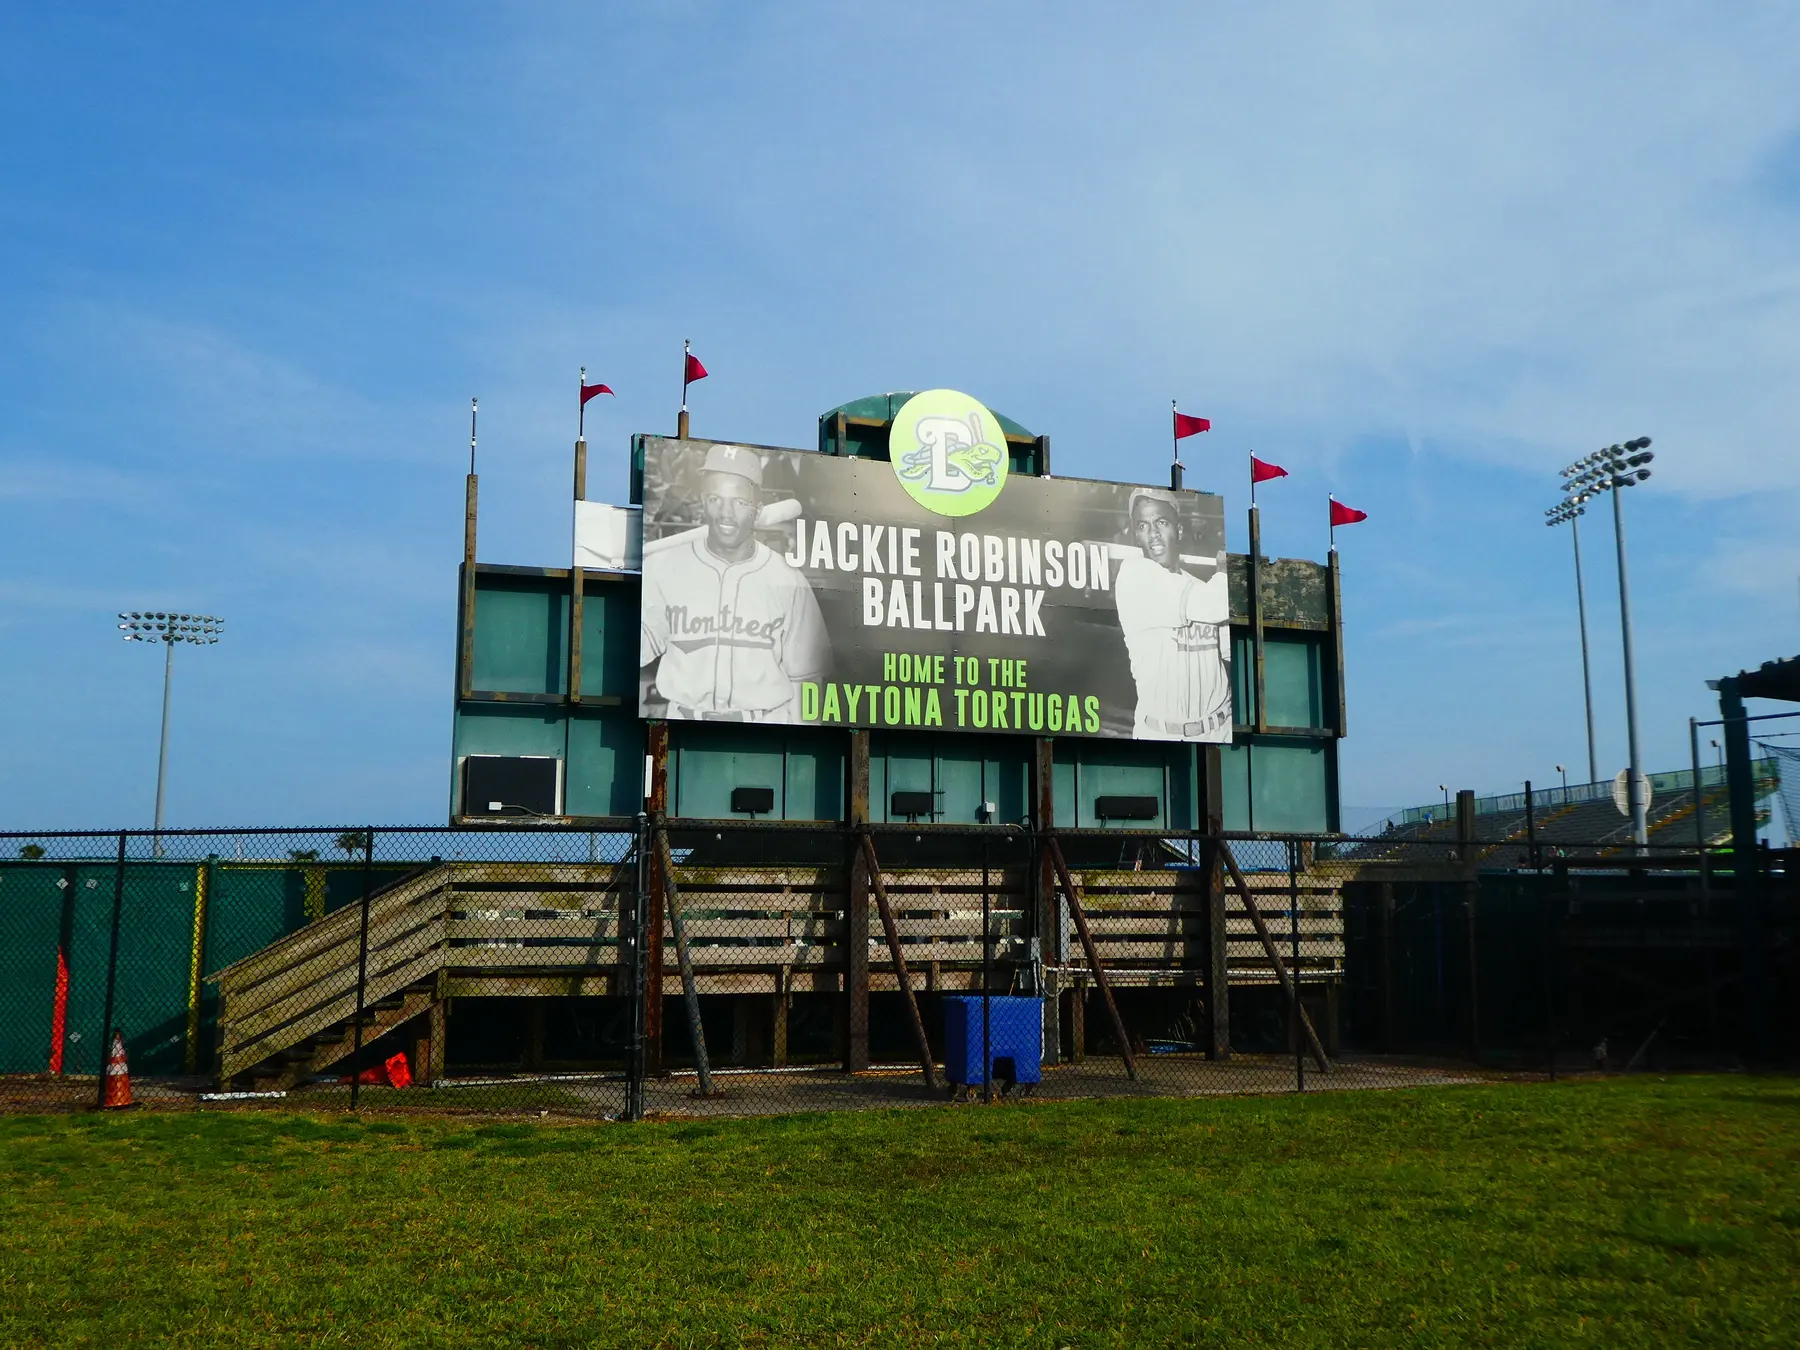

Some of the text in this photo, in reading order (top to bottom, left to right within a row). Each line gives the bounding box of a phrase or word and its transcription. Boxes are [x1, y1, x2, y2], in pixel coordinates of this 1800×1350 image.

[723, 445, 738, 460] M
[784, 518, 1110, 591] JACKIE ROBINSON
[862, 576, 1047, 637] BALLPARK
[883, 652, 1027, 688] HOME TO THE
[801, 681, 1100, 734] DAYTONA TORTUGAS
